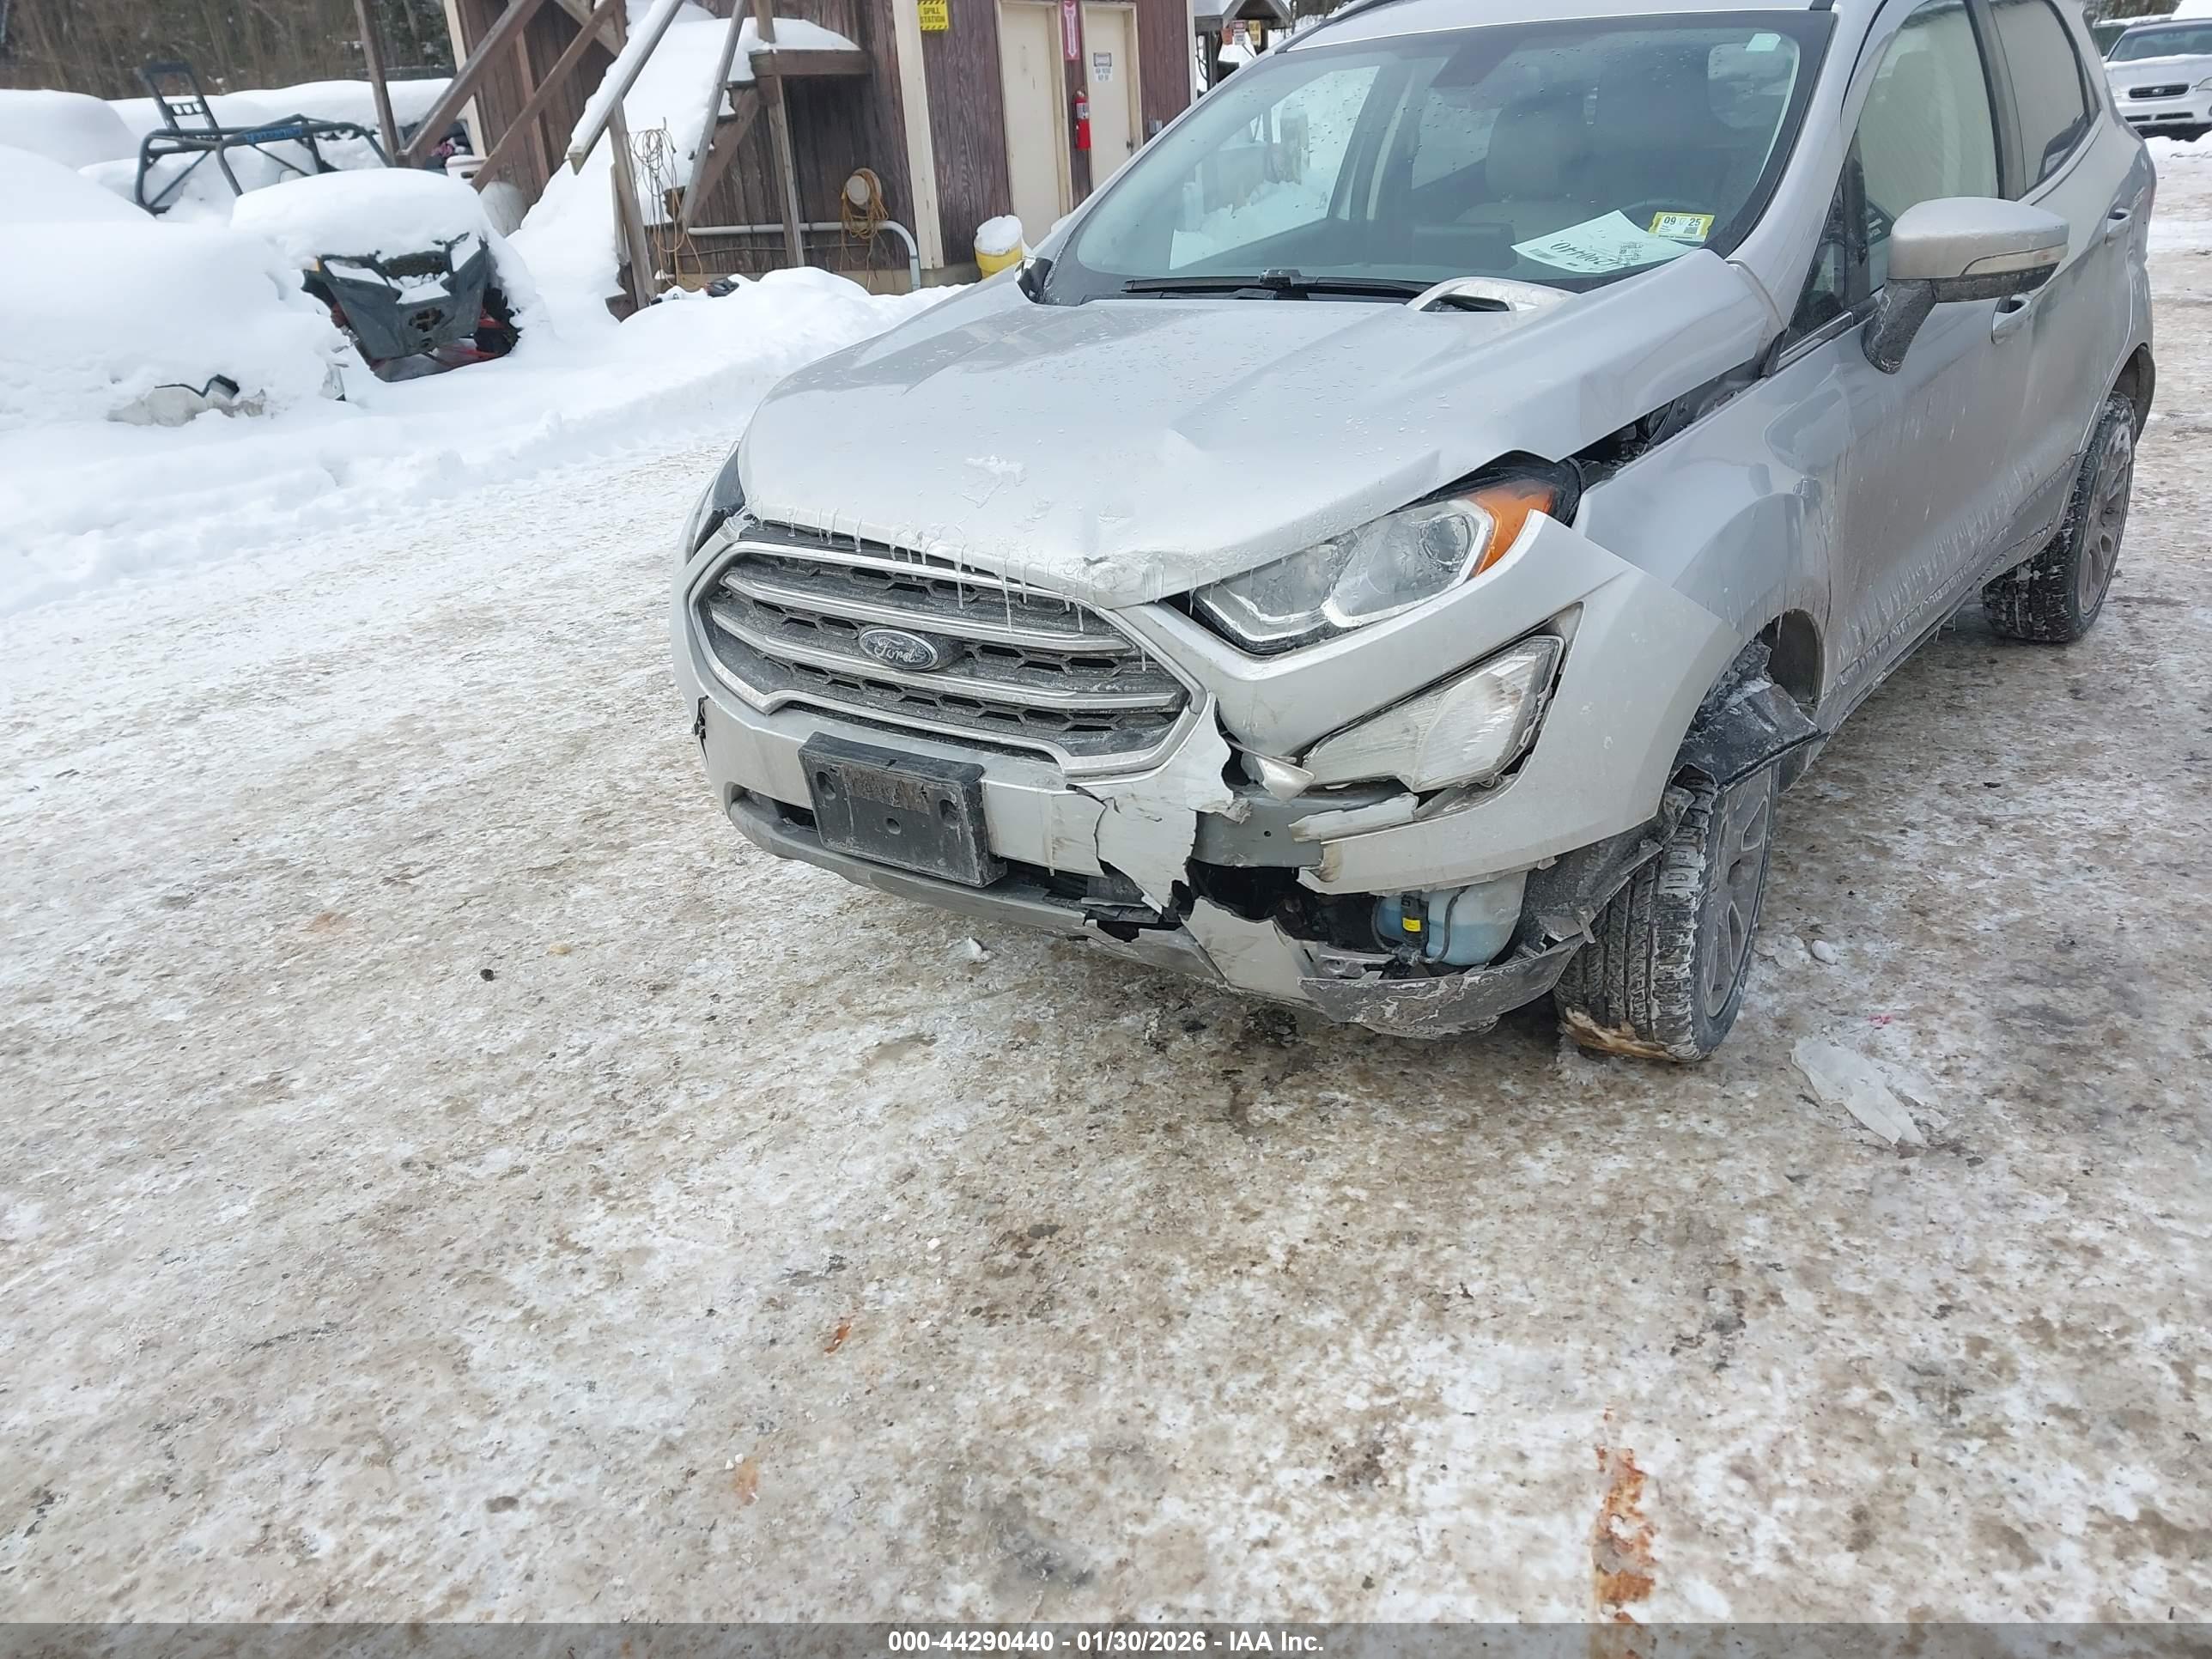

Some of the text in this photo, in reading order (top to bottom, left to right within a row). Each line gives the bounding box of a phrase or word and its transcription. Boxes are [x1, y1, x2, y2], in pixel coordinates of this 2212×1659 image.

[920, 15, 945, 24] STATION
[1663, 216, 1701, 227] 09 25
[874, 636, 917, 663] Ford
